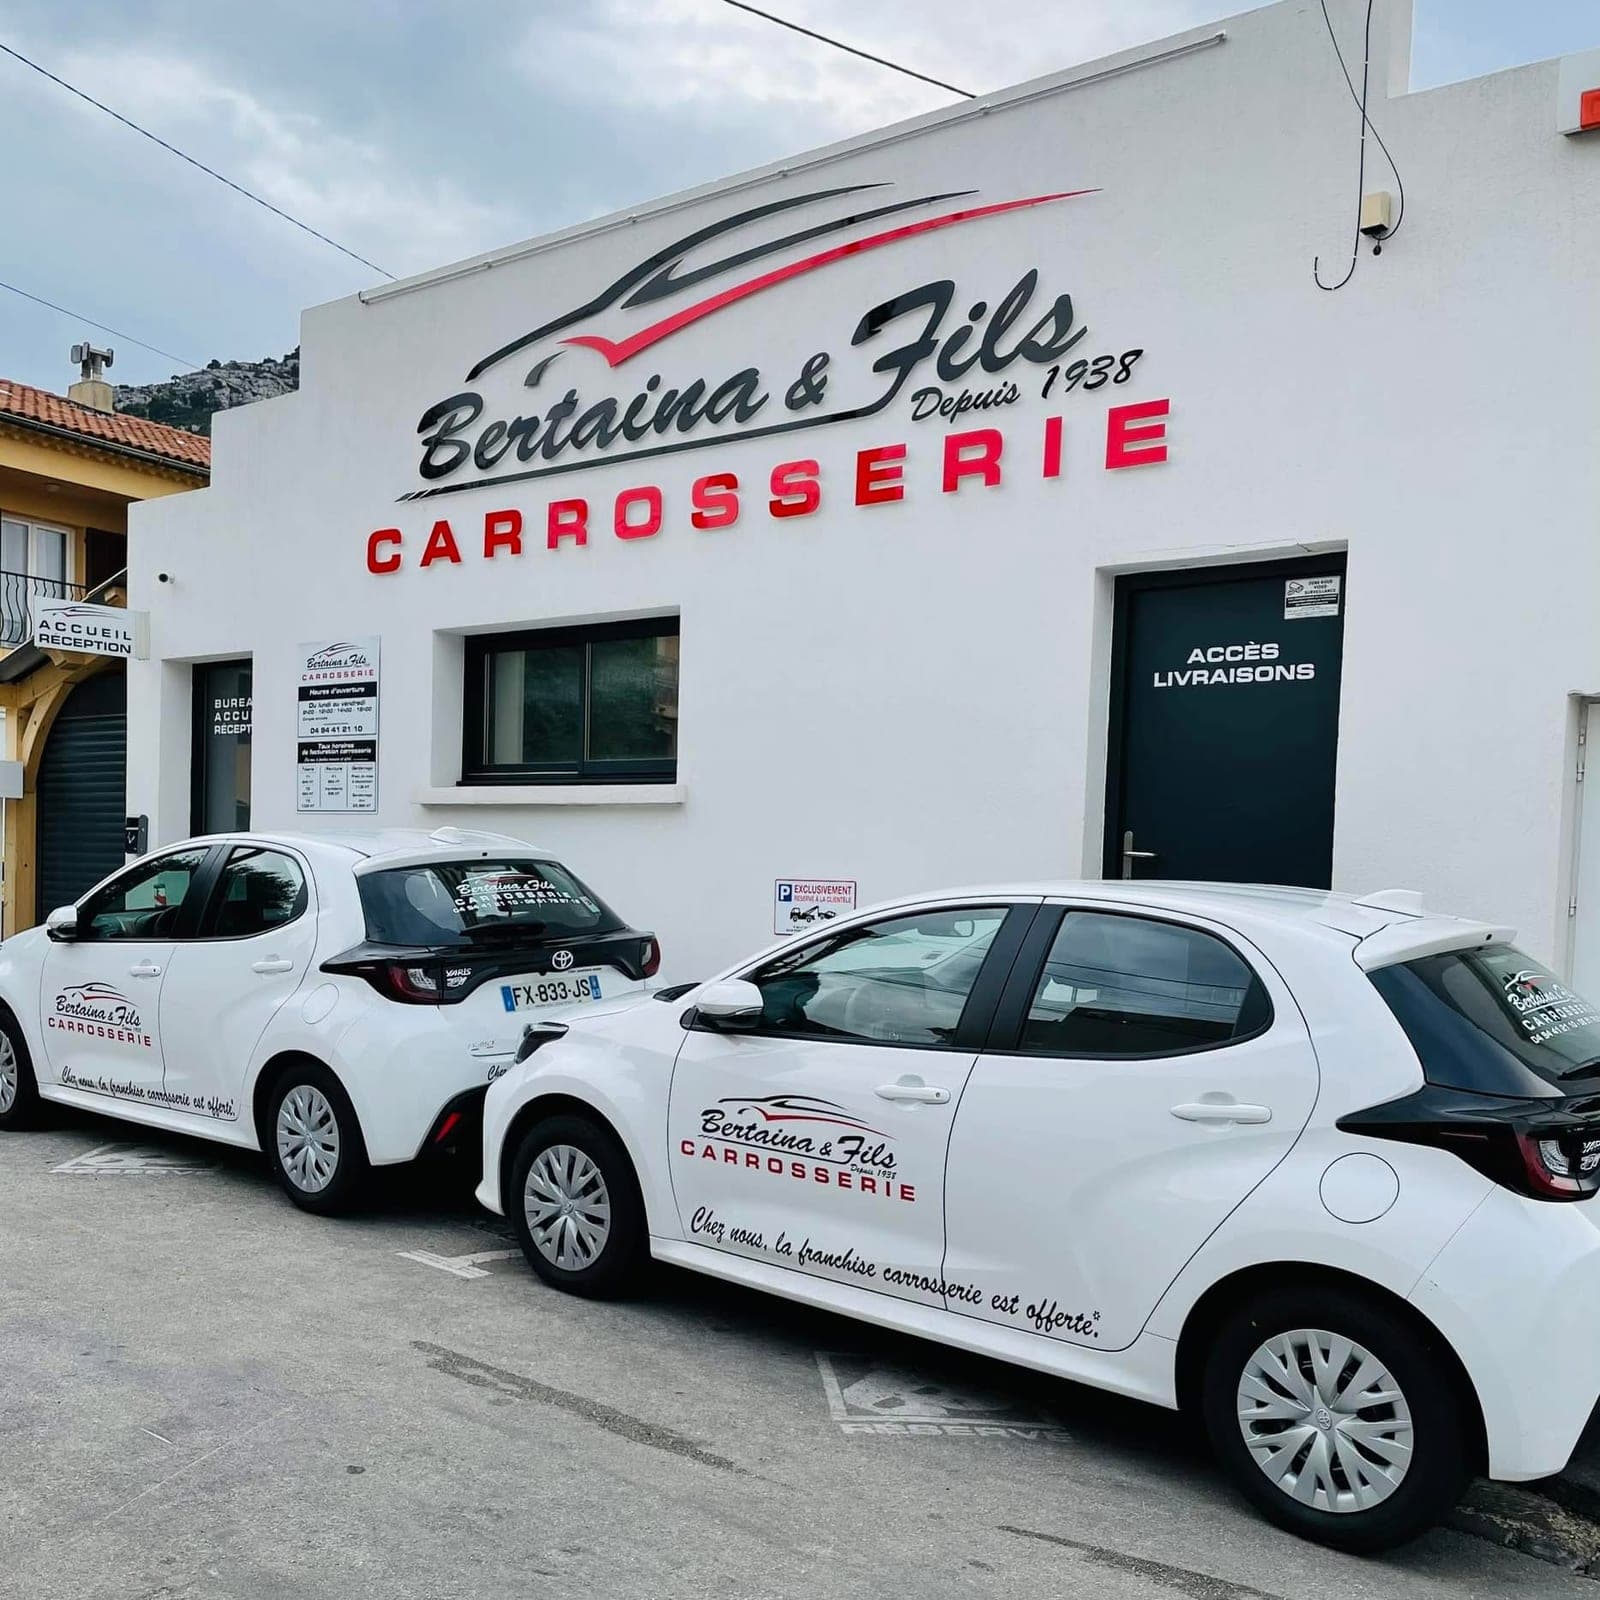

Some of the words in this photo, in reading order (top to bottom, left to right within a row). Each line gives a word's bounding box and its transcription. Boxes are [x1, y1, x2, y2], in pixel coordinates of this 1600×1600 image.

[416, 368, 769, 480] Bertaina
[785, 352, 829, 410] &
[850, 268, 1088, 419] Fils
[910, 381, 1021, 424] Depuis
[1041, 348, 1144, 399] 1938
[367, 398, 1170, 574] CARROSSERIE
[39, 620, 132, 641] ACCUEIL
[306, 657, 342, 669] Bertaina
[349, 653, 367, 667] Fils
[1187, 641, 1279, 664] ACCÈS
[301, 668, 375, 681] CARROSSERIE
[1153, 663, 1315, 688] LIVRAISONS
[214, 697, 252, 709] BUREA
[214, 711, 249, 722] ACCU
[214, 722, 253, 735] RÉCEPT
[794, 884, 852, 895] EXCLUSIVEMENT
[446, 967, 472, 977] YARIS
[512, 978, 591, 1007] FX-833-JS
[56, 995, 106, 1020] Bertaina
[115, 1006, 141, 1027] Fils
[48, 1017, 152, 1047] CARROSSERIE
[487, 1065, 507, 1081] Che
[61, 1065, 79, 1088] Chez
[98, 1076, 109, 1091] la
[109, 1078, 146, 1097] franchise
[147, 1089, 190, 1107] carrosserie
[193, 1096, 205, 1110] est
[701, 1108, 816, 1153] Bertaina
[819, 1141, 832, 1156] &
[837, 1135, 898, 1169] Fils
[1582, 1140, 1600, 1154] YAR
[681, 1140, 916, 1202] CARROSSERIE
[850, 1163, 874, 1176] Depuis
[877, 1169, 898, 1180] 1938
[690, 1206, 726, 1244] Chez
[775, 1231, 793, 1256] la
[798, 1237, 877, 1278] franchise
[883, 1267, 983, 1305] carrosserie
[991, 1294, 1020, 1315] est
